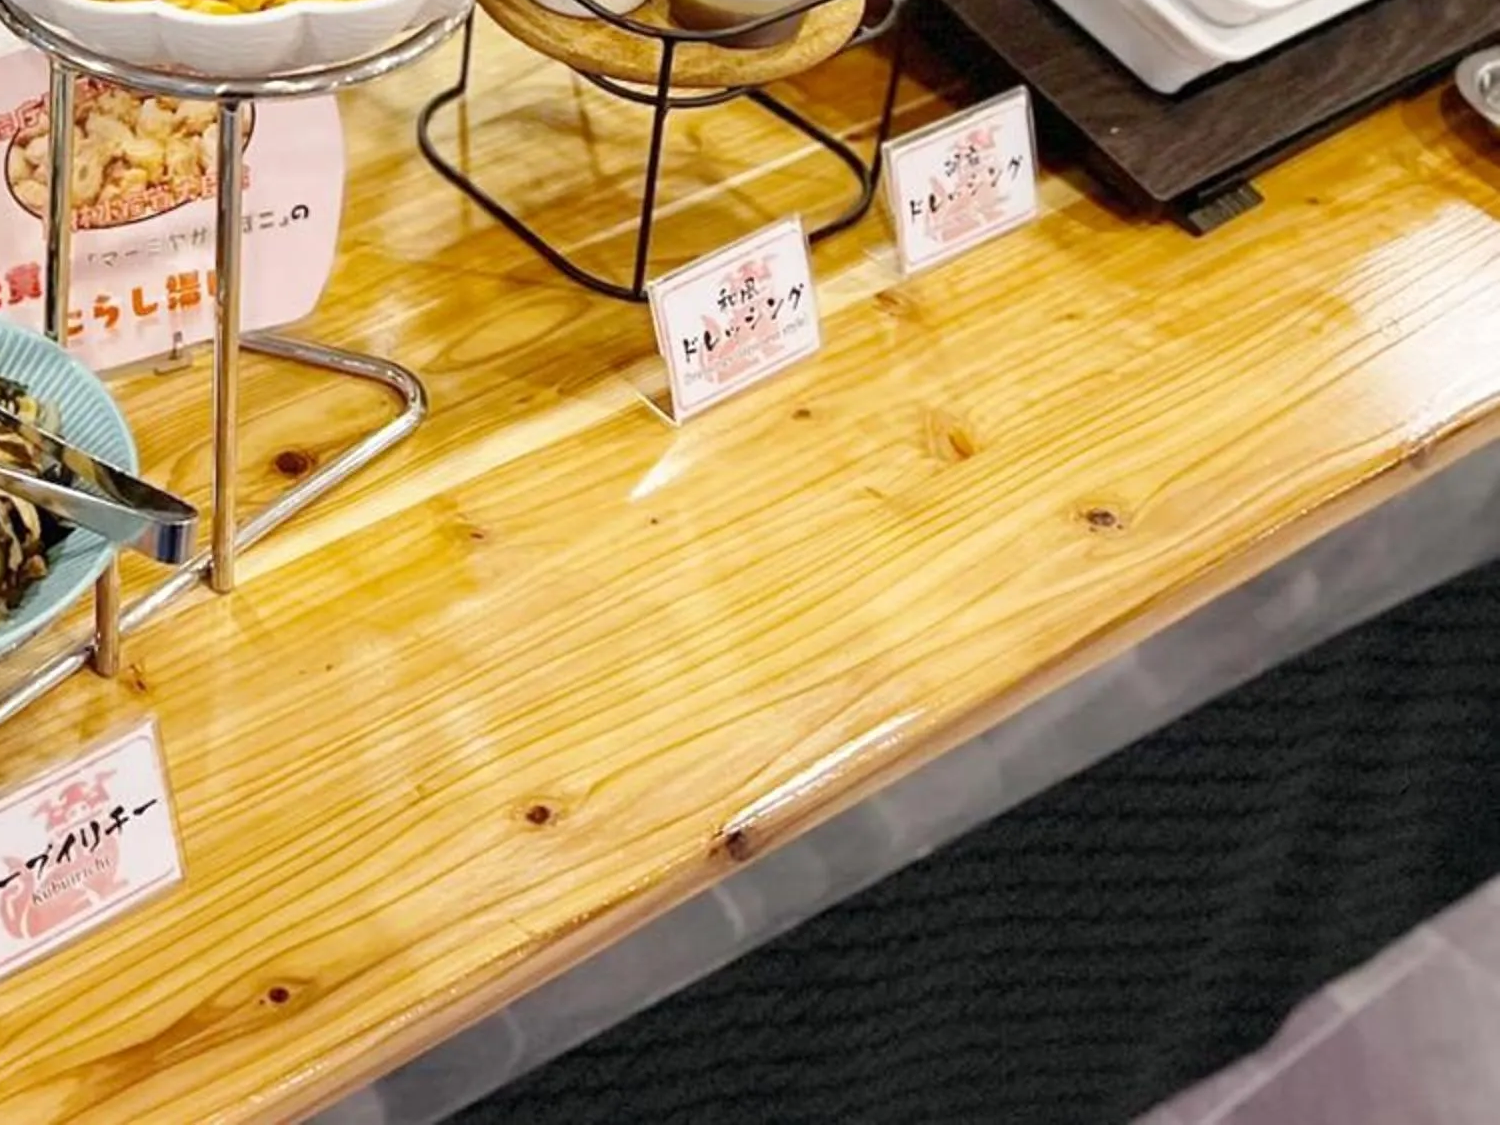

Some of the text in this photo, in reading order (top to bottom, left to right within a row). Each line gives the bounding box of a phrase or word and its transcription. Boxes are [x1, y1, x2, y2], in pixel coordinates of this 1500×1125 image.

[682, 282, 805, 363] ドレッシング
